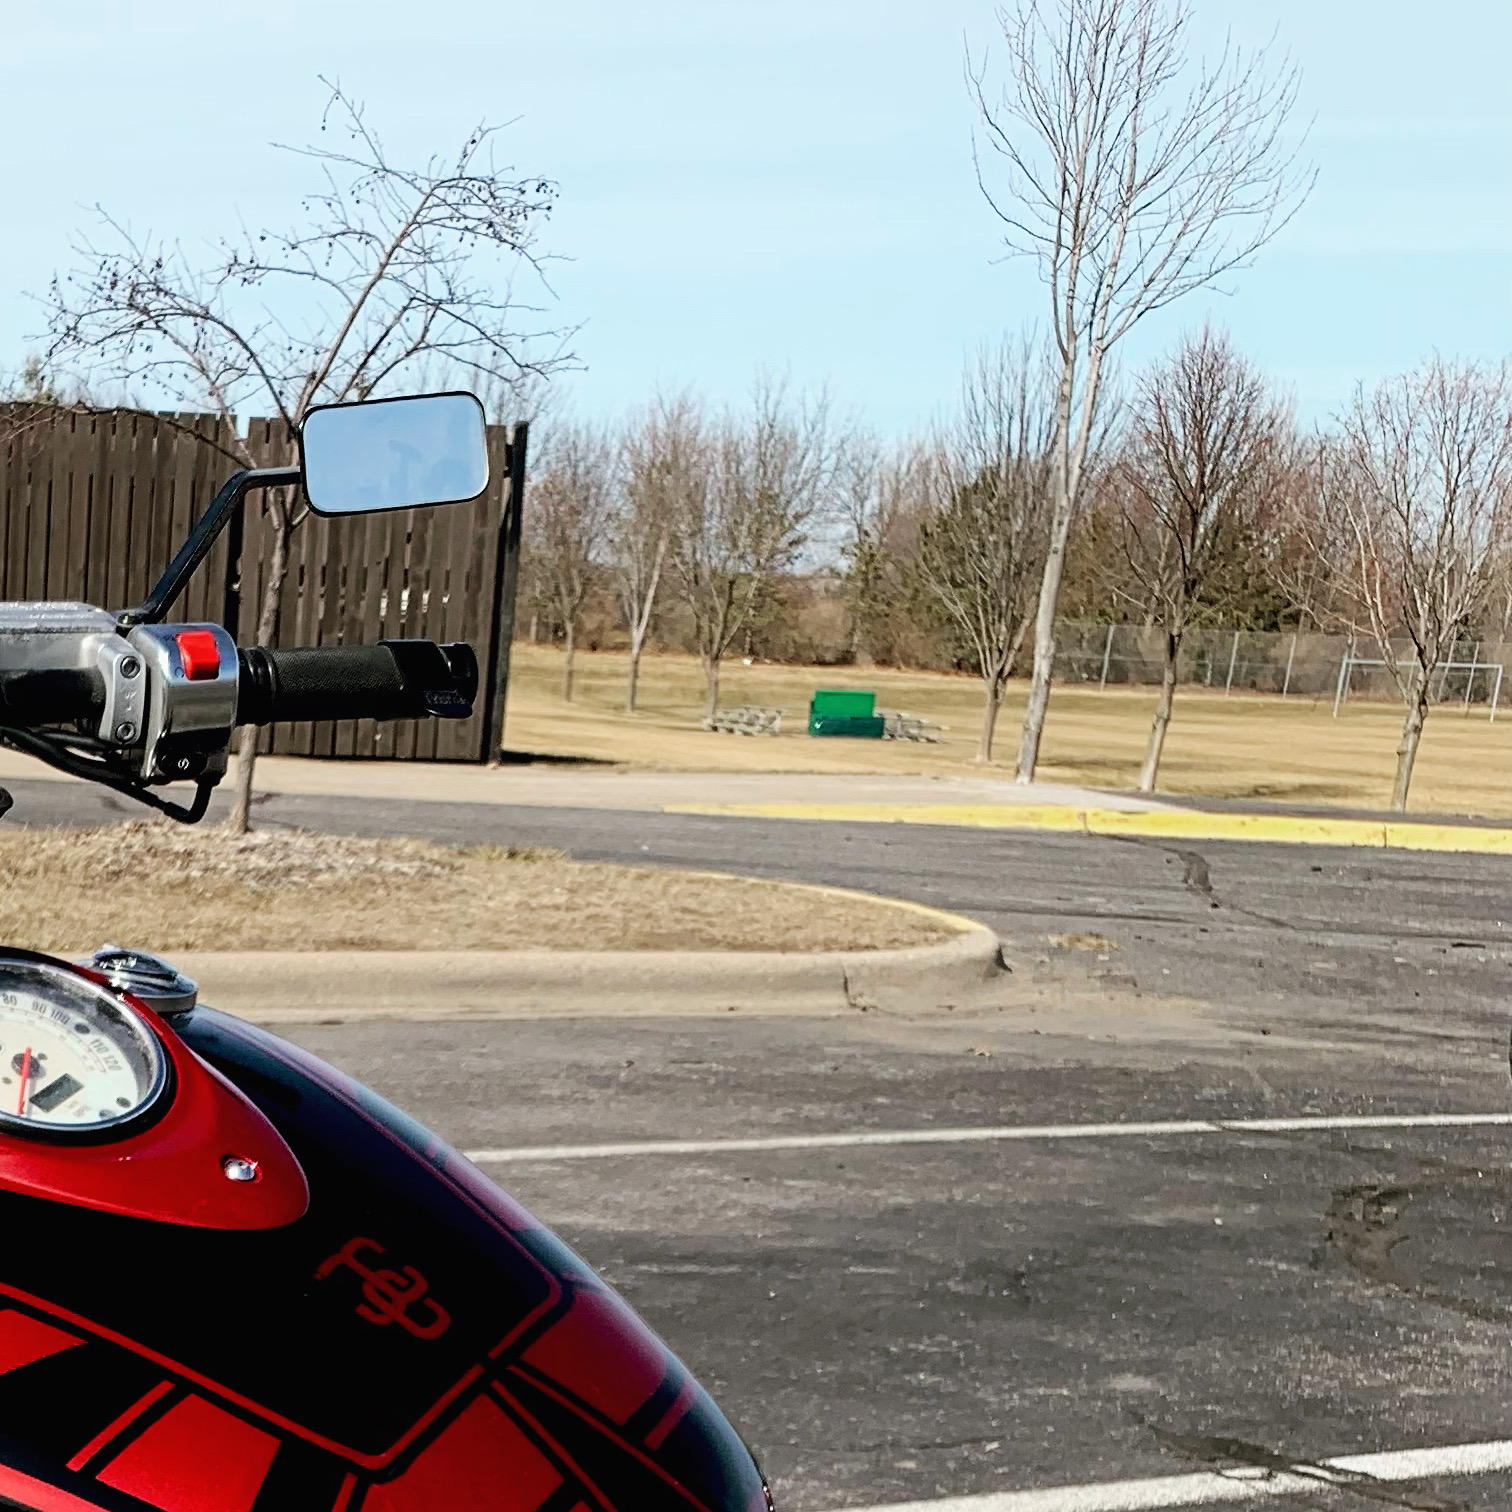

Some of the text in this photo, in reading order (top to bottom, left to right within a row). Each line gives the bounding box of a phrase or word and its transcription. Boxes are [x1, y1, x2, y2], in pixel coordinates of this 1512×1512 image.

[1, 993, 18, 1006] 80
[32, 1001, 47, 1014] 90
[50, 1008, 71, 1025] 100
[90, 1038, 110, 1054] 110
[103, 1055, 123, 1071] 120
